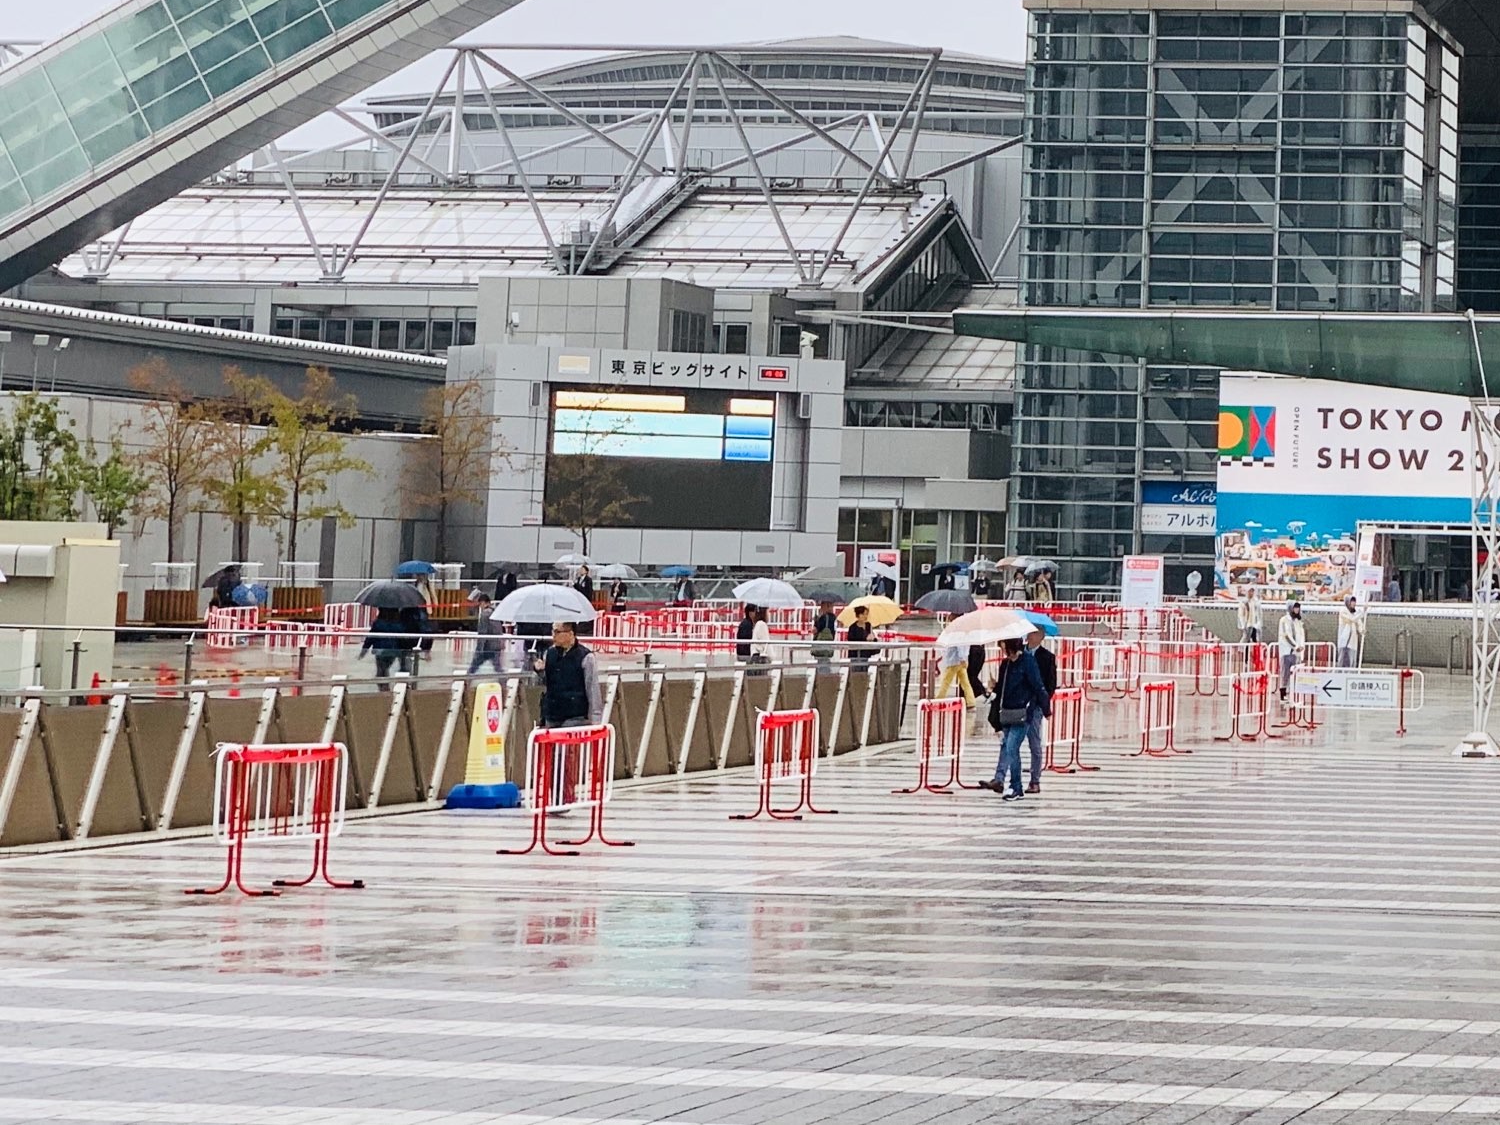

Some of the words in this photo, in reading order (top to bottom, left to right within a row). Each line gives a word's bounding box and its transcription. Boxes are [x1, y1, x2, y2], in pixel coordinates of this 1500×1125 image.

[611, 359, 748, 379] 東京ビッグサイト
[1317, 408, 1442, 431] TOKYO
[1317, 447, 1429, 471] SHOW
